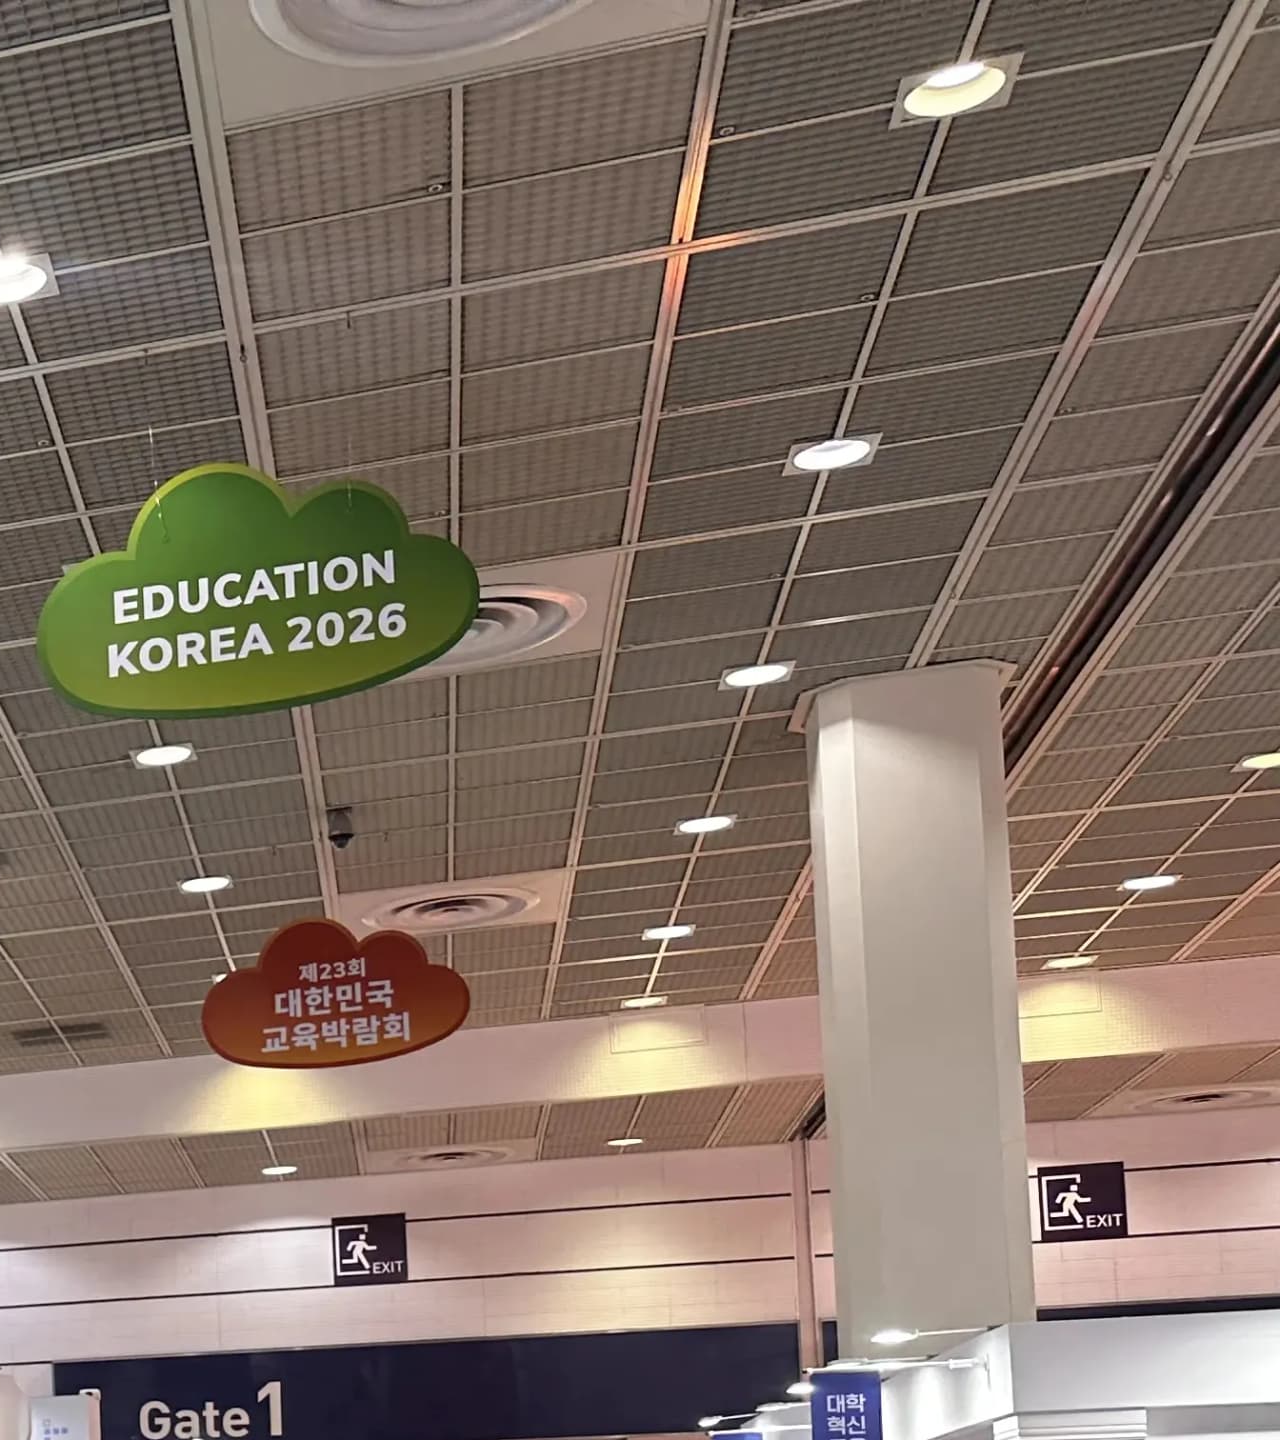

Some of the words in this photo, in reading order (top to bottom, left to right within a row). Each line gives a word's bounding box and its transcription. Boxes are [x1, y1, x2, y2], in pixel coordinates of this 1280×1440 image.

[112, 550, 395, 625] EDUCATION
[107, 623, 274, 679] KOREA
[286, 602, 408, 652] 2026
[298, 957, 367, 983] 제23회
[274, 979, 395, 1018] 대한민국
[261, 1011, 411, 1053] 교육박람회
[1086, 1212, 1125, 1229] EXIT
[372, 1260, 404, 1275] EXIT
[139, 1400, 251, 1440] Gate
[257, 1380, 283, 1437] 1
[826, 1393, 867, 1413] 대학
[827, 1415, 867, 1435] 혁신
